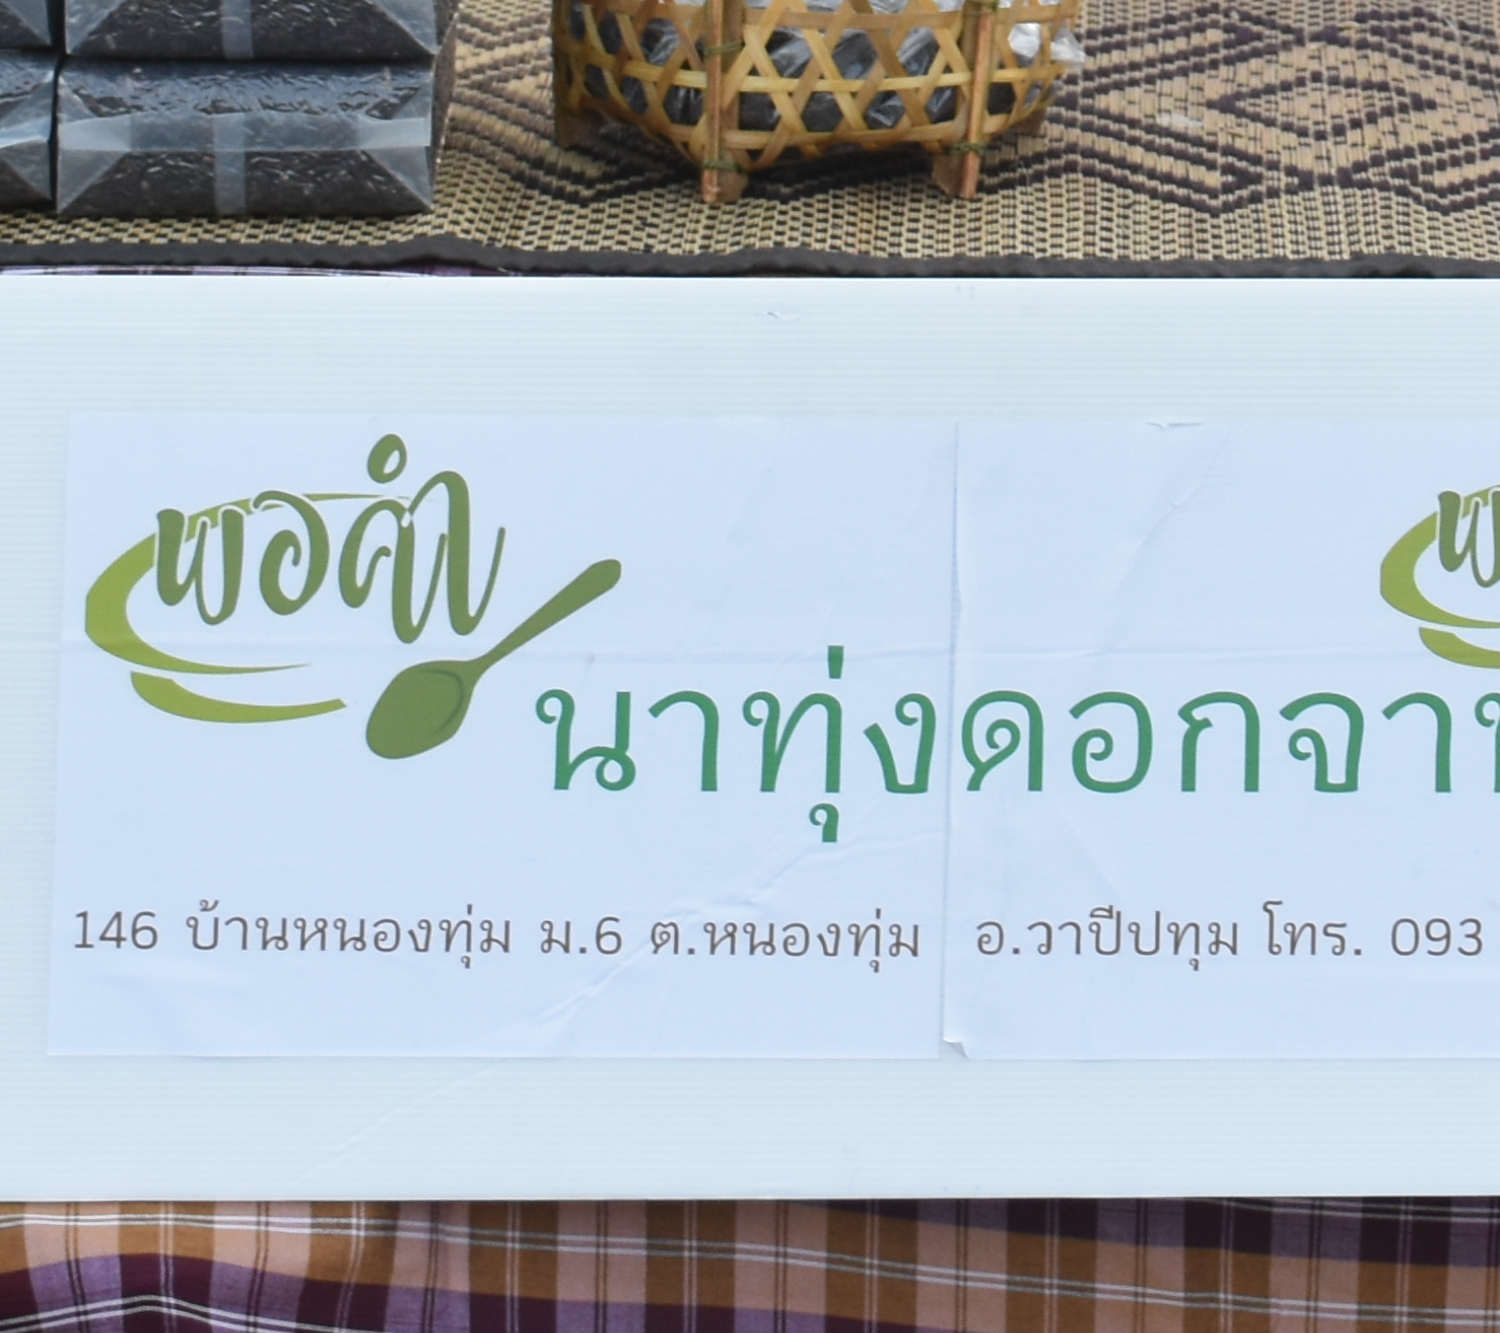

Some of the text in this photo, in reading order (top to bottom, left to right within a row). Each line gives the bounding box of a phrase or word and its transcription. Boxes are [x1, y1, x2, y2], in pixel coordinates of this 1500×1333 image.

[74, 911, 158, 950] 146
[185, 899, 511, 969] บ้านหนองทุ่ม
[540, 916, 622, 955] ม.6
[650, 908, 920, 974] ต.หนองทุ่ม
[975, 904, 1238, 972] อ.วาปีปทุม
[1262, 900, 1363, 956] โทร.
[1390, 918, 1484, 958] 093
